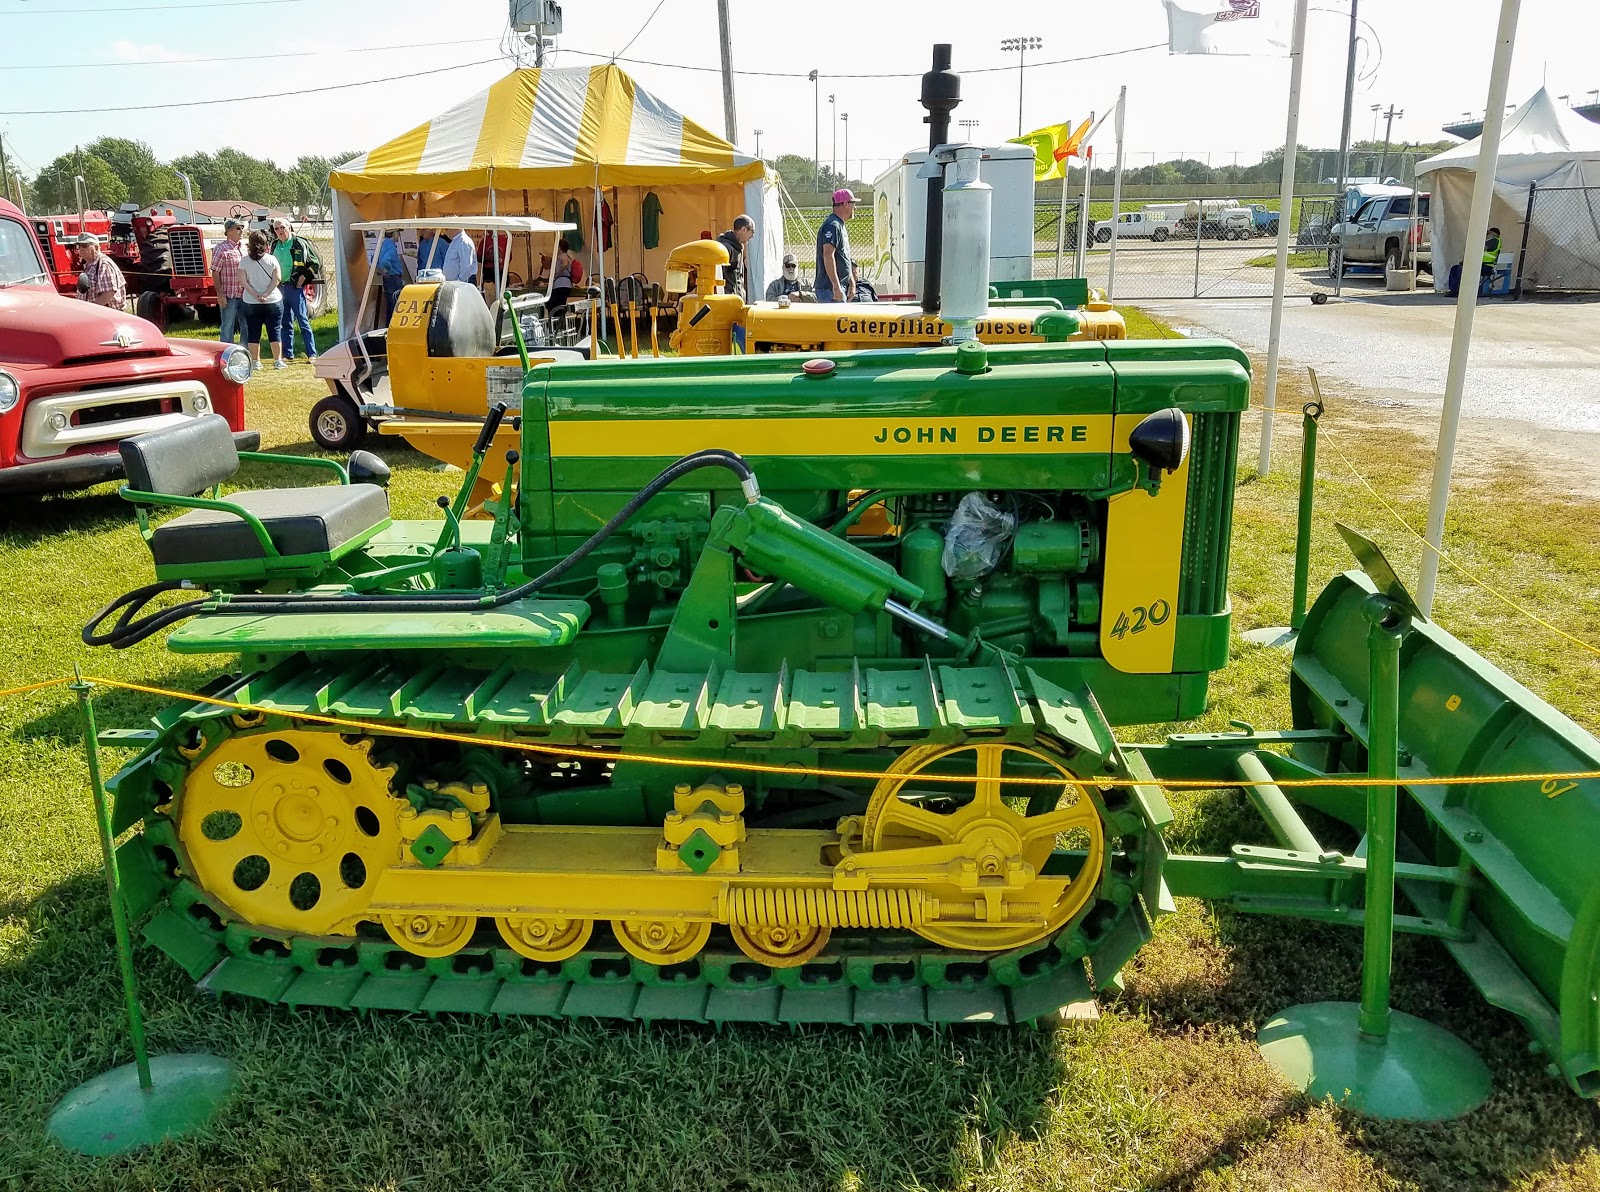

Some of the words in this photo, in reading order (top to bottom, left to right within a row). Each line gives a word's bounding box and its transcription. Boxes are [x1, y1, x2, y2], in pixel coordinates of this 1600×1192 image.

[395, 300, 433, 314] CAT
[836, 316, 945, 338] Caterpillar
[873, 427, 957, 443] JOHN
[978, 426, 1088, 442] DEERE
[1109, 598, 1171, 641] 420
